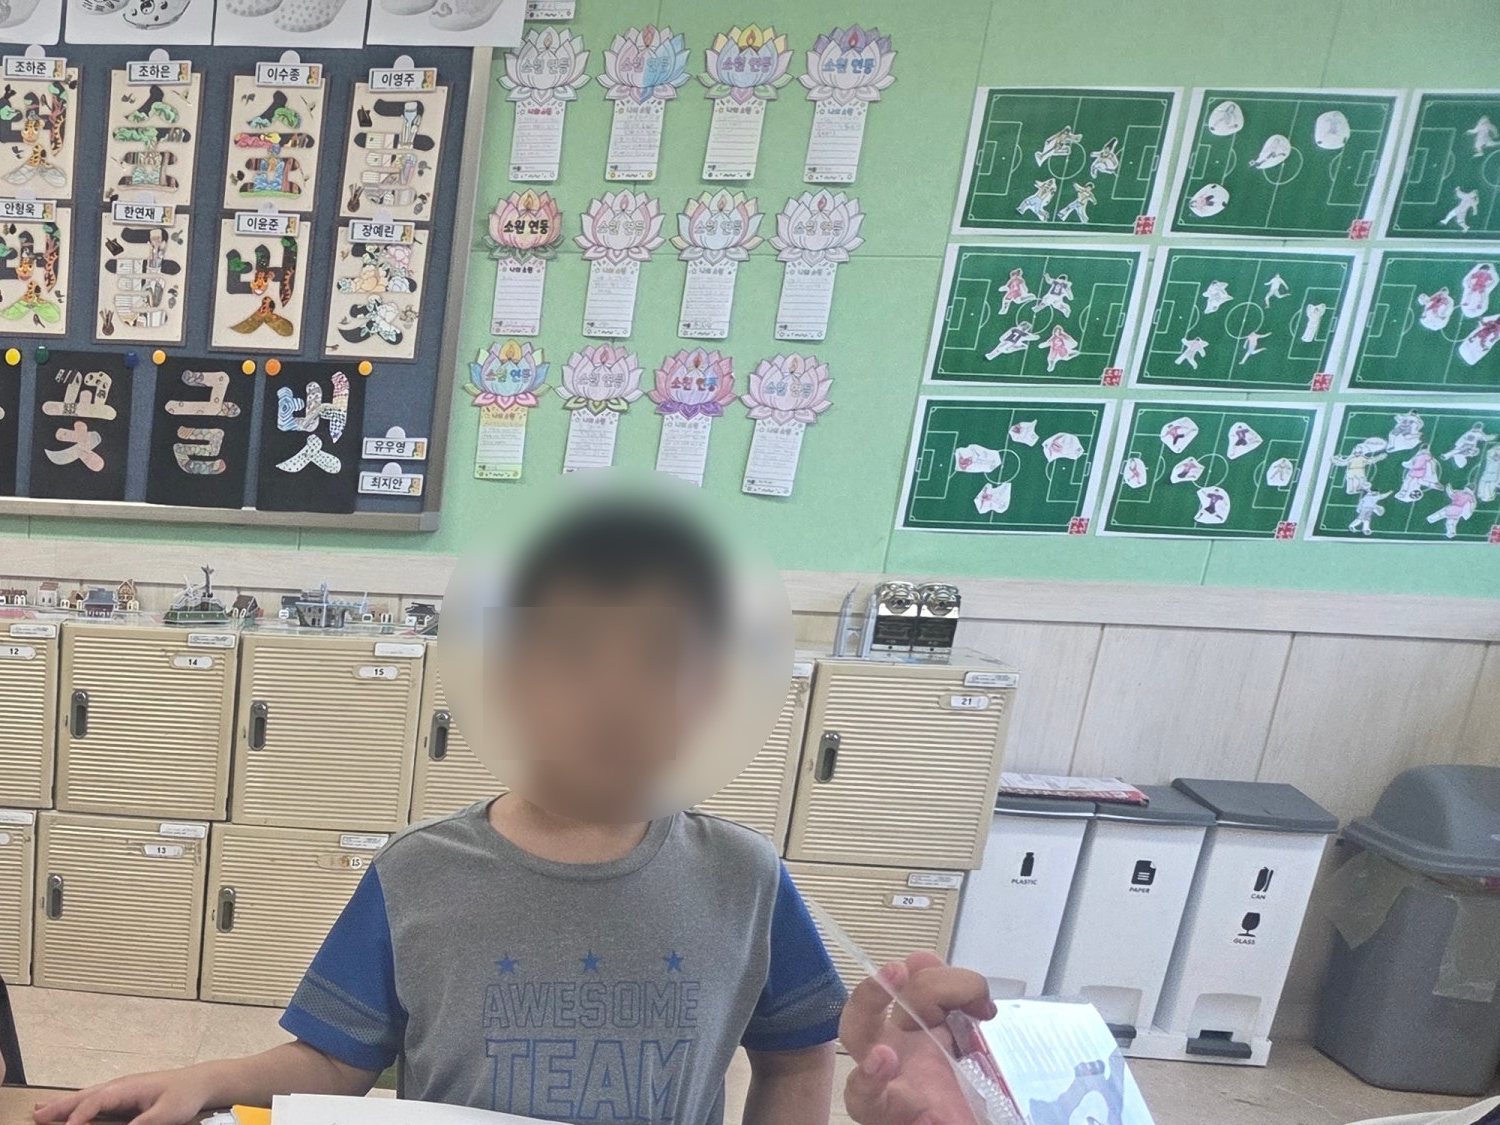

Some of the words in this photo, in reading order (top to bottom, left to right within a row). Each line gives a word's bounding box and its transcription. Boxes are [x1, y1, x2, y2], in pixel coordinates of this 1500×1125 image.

[14, 62, 47, 75] 조하준
[138, 65, 171, 79] 조하은
[822, 58, 848, 73] 소원
[267, 67, 300, 82] 이수종
[382, 72, 415, 87] 이영주
[4, 203, 36, 216] 안형욱
[124, 206, 155, 220] 한연재
[247, 216, 279, 231] 이윤준
[503, 220, 526, 234] 소원
[528, 219, 549, 234] 연등
[362, 224, 394, 238] 장예린
[42, 369, 117, 472] 꽃
[164, 370, 241, 474] 글
[275, 371, 349, 474] 벗
[374, 440, 406, 454] 유우영
[371, 477, 403, 490] 최지안
[188, 658, 198, 666] 14
[374, 668, 385, 676] 15
[961, 697, 972, 706] 21
[156, 846, 167, 854] 13
[1011, 878, 1038, 886] PLASTIC
[1129, 886, 1151, 894] PAPER
[903, 896, 914, 905] 20
[1233, 937, 1256, 945] GLASS
[482, 981, 700, 1029] AWESOME
[486, 1038, 692, 1121] TEAM
